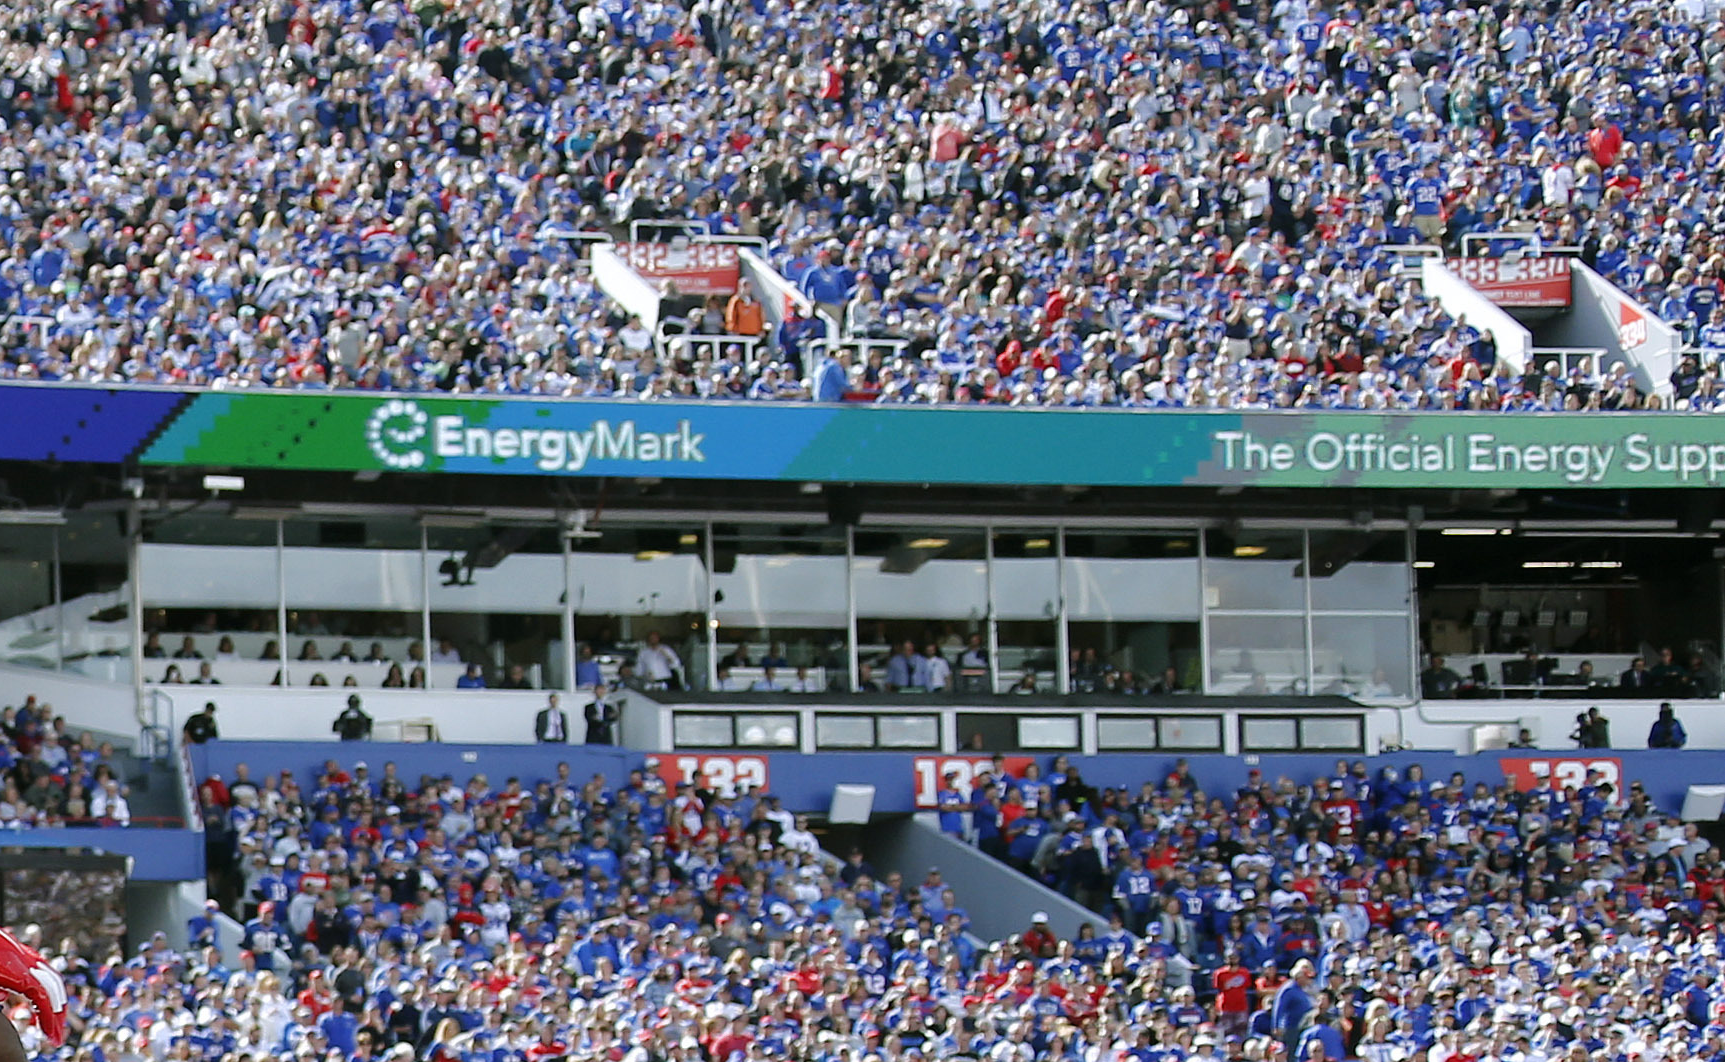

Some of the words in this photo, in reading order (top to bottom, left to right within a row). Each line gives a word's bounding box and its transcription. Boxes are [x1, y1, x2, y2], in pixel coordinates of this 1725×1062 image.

[434, 415, 705, 471] EnergyMark
[1215, 431, 1294, 471] The
[1307, 431, 1455, 472] Official
[1469, 434, 1614, 483] Energy
[1625, 433, 1725, 481] Supp
